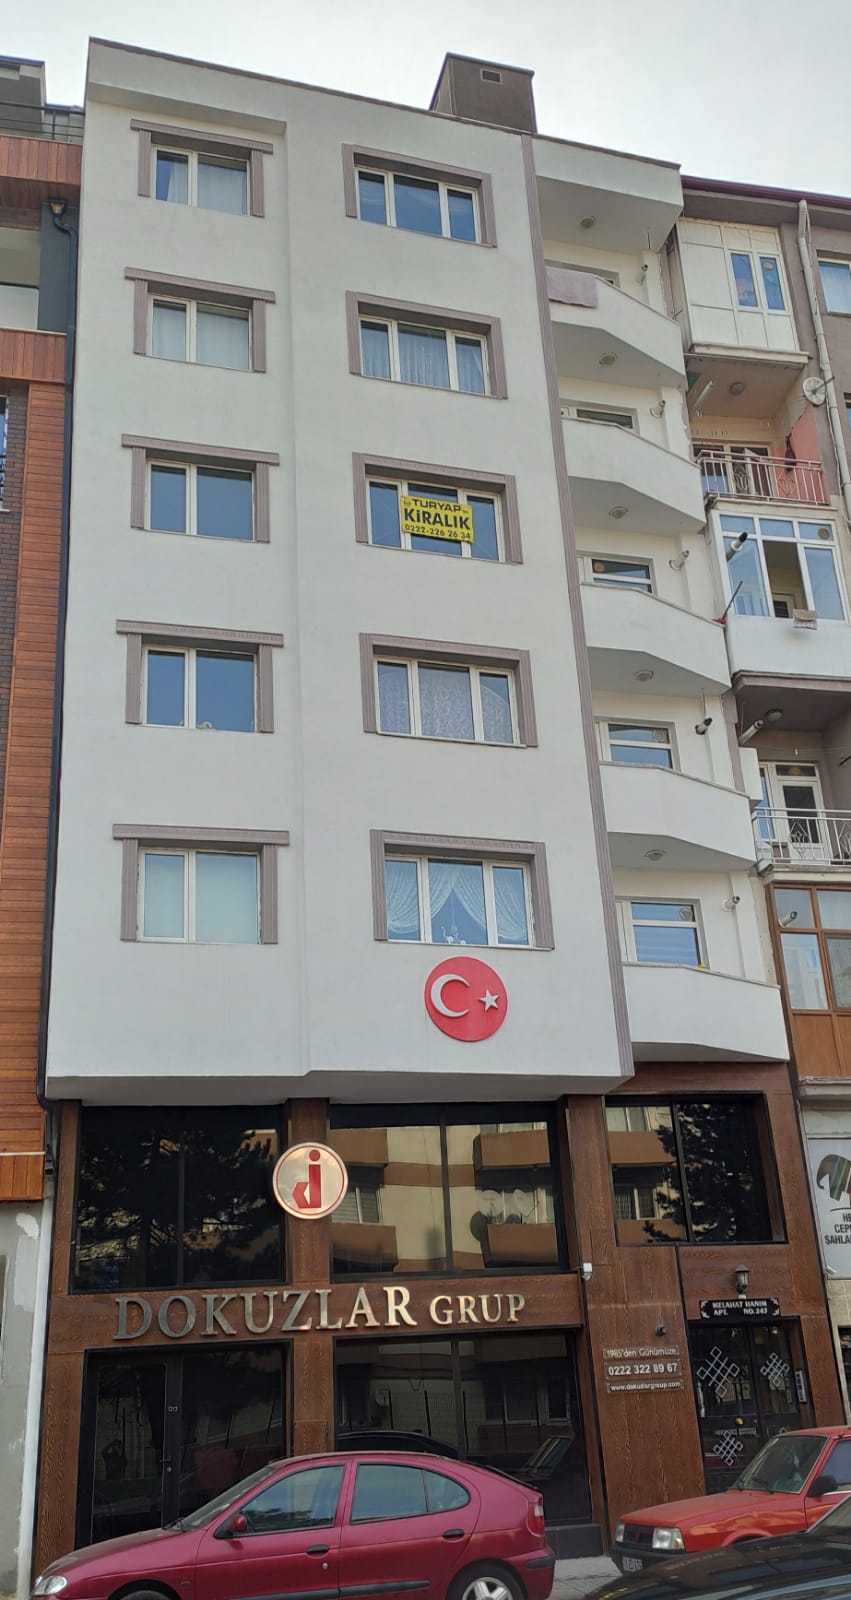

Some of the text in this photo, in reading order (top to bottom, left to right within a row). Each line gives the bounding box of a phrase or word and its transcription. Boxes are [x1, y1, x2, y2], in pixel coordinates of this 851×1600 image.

[411, 498, 462, 513] TURYAP
[448, 530, 459, 538] 26
[461, 532, 471, 540] 34
[112, 1285, 527, 1341] DOKUZLAR GRUP
[608, 1362, 678, 1376] 0222 322 89 67
